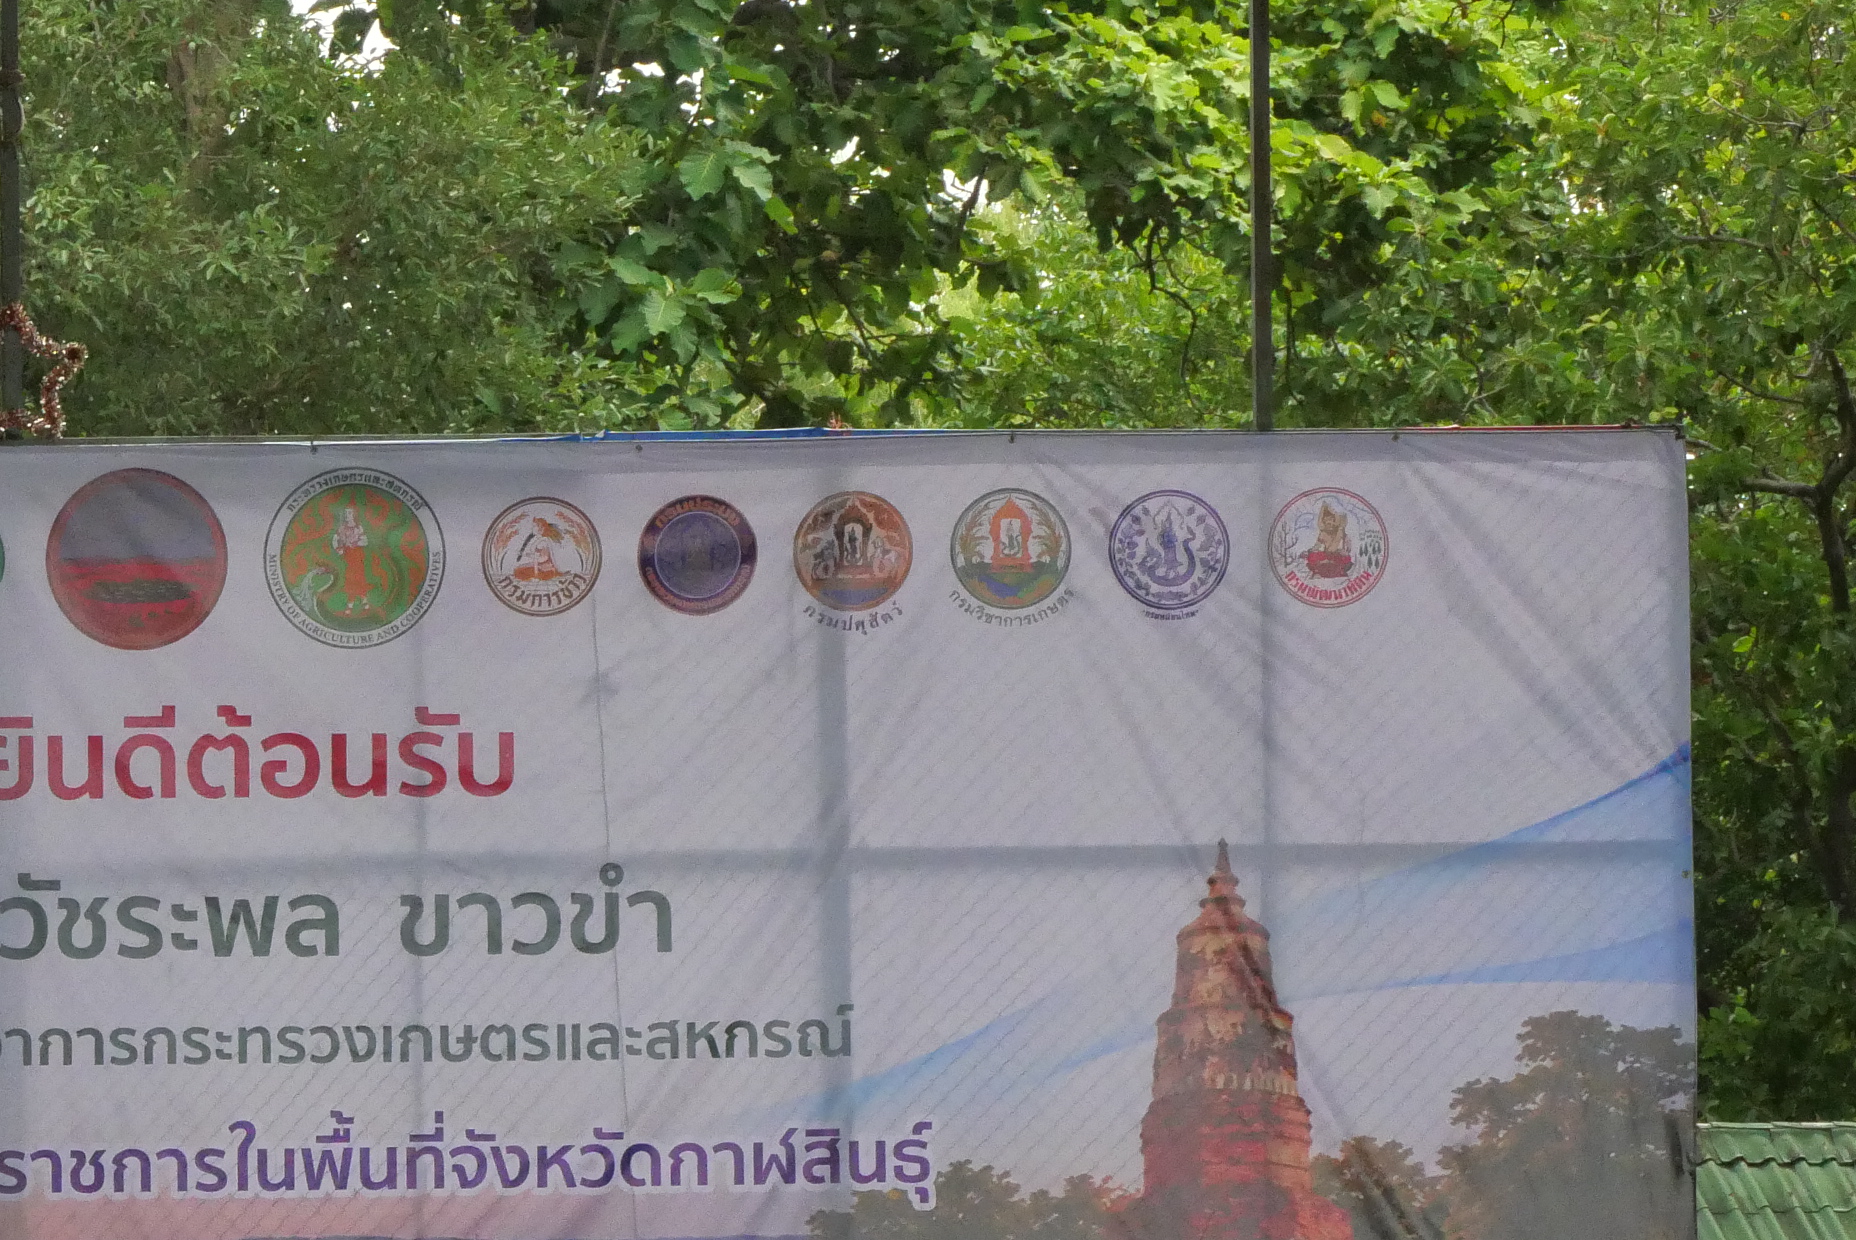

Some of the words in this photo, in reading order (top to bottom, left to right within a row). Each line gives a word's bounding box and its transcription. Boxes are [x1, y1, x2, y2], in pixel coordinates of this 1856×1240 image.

[267, 554, 291, 606] MINISTRY
[298, 617, 375, 645] AGRICULTURE
[375, 623, 400, 643] AND
[399, 550, 442, 629] COOPERATIVES
[497, 572, 588, 608] กรมการข้าว
[948, 586, 1076, 628] กรมวิชาการเกษตร
[802, 600, 904, 636] กรมปศุสัตว์
[399, 862, 674, 956] ขาวขำ
